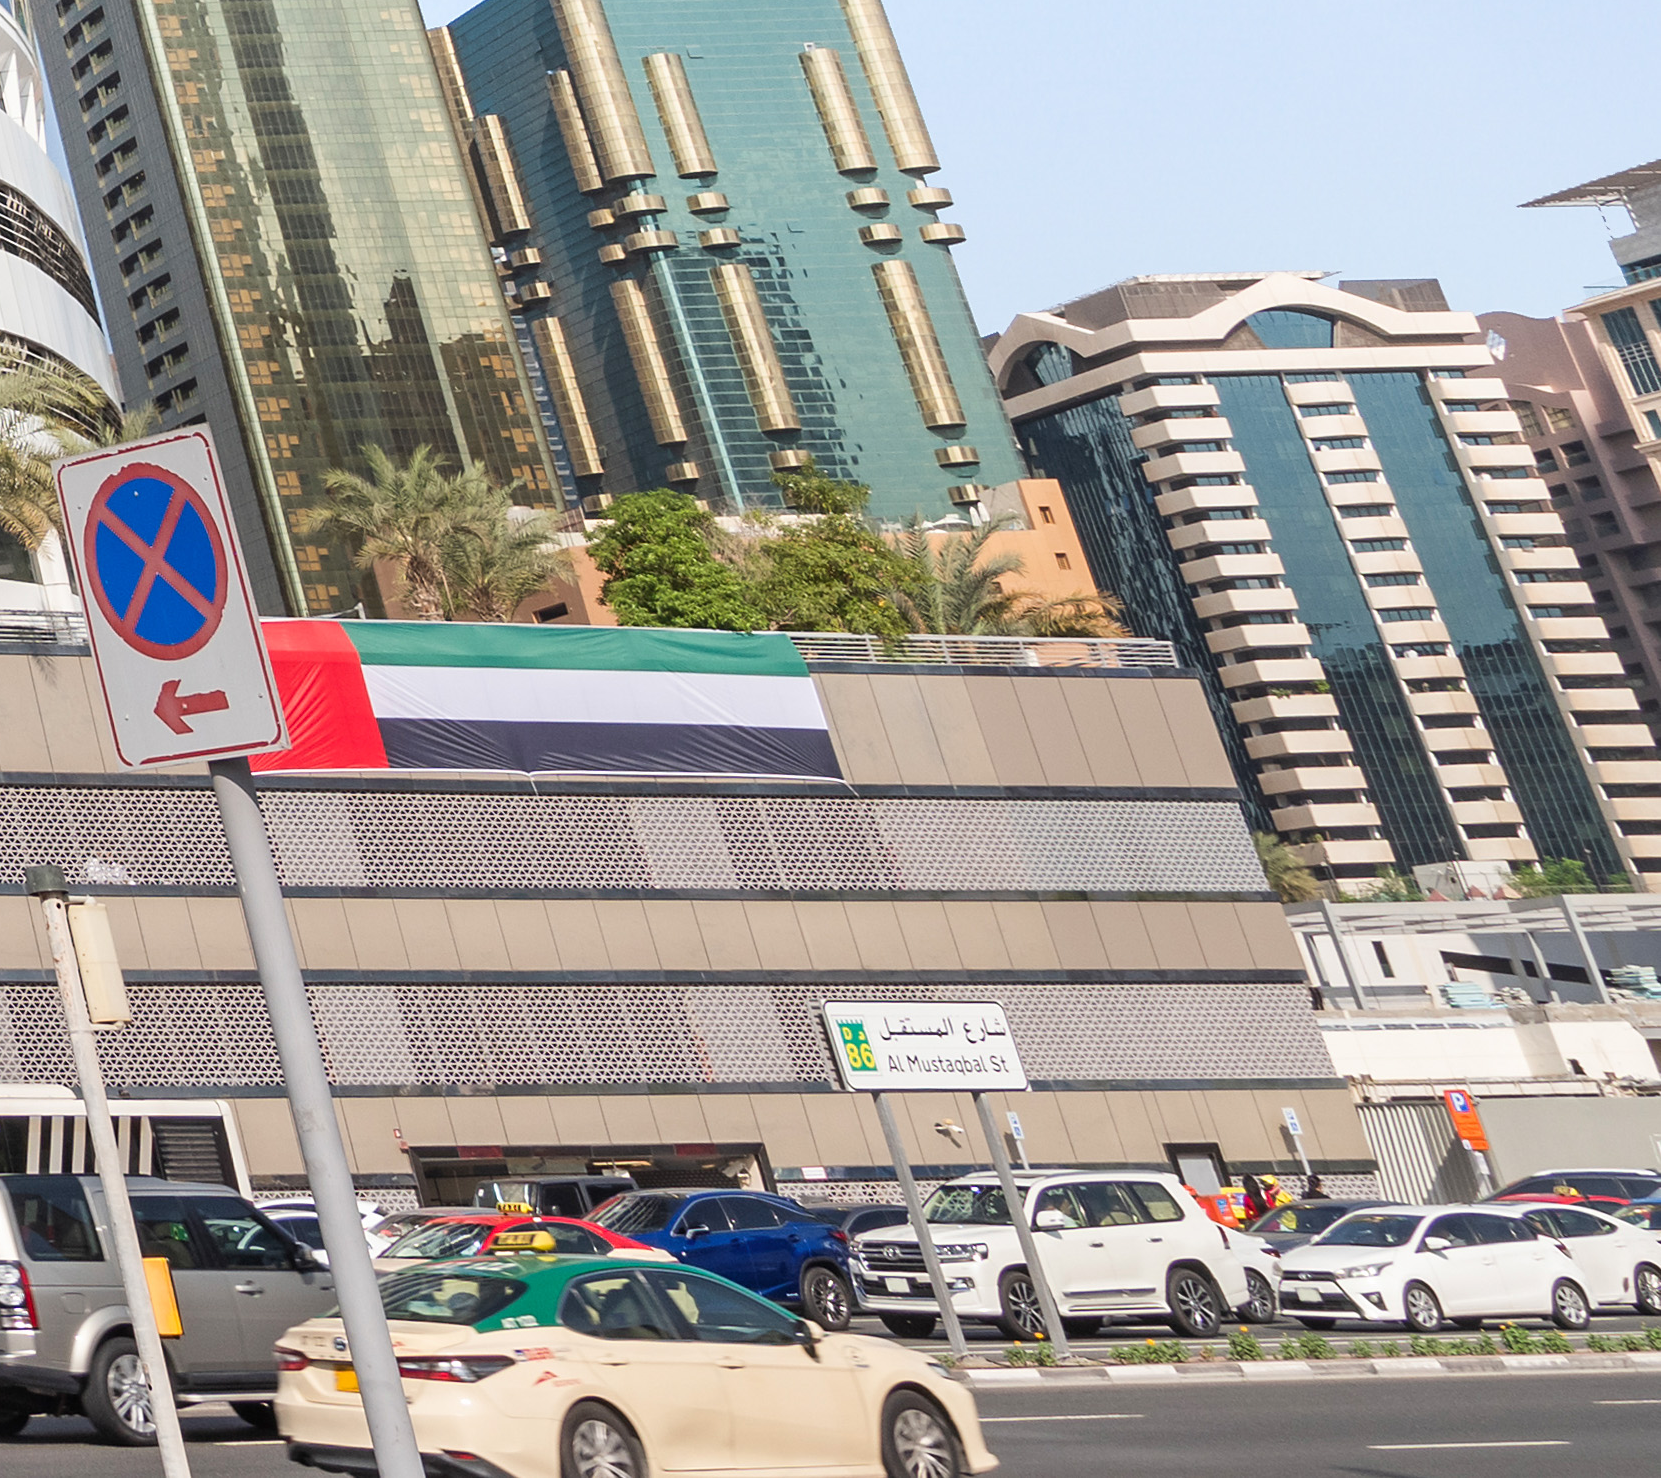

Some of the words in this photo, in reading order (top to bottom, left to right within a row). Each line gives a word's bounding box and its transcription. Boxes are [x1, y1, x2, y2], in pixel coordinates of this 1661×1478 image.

[842, 1027, 853, 1040] D
[879, 1017, 955, 1042] المستقبل
[963, 1018, 1006, 1044] شارع
[846, 1043, 875, 1069] 86
[888, 1054, 904, 1073] Al
[906, 1055, 988, 1076] Mustaqbal
[989, 1055, 1010, 1073] St
[498, 1203, 521, 1212] TAXI
